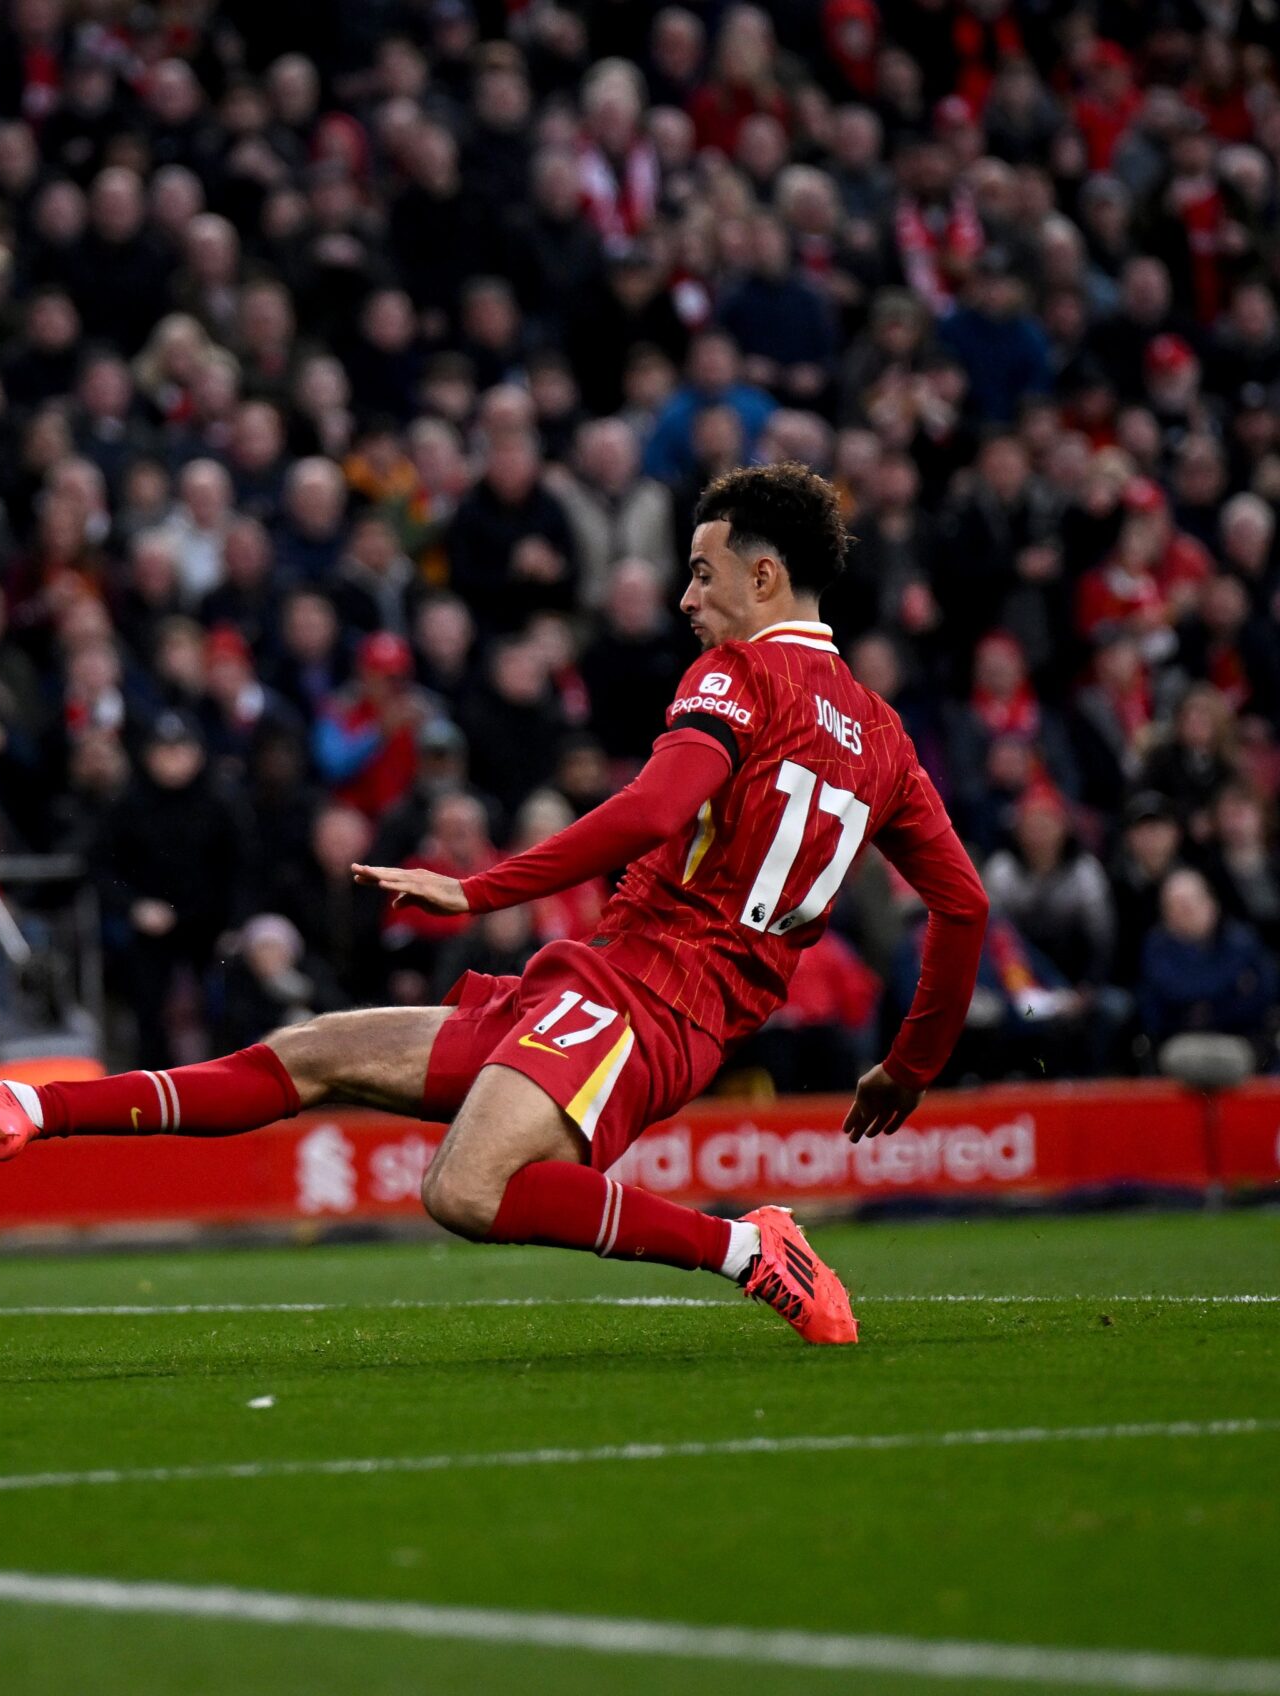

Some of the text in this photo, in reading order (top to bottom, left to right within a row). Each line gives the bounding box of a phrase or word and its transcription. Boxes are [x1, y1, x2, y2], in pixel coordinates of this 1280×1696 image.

[671, 696, 752, 726] Expedia
[814, 694, 863, 756] JONES
[739, 759, 871, 936] 17
[533, 990, 618, 1048] 17
[697, 1105, 1036, 1190] chartered
